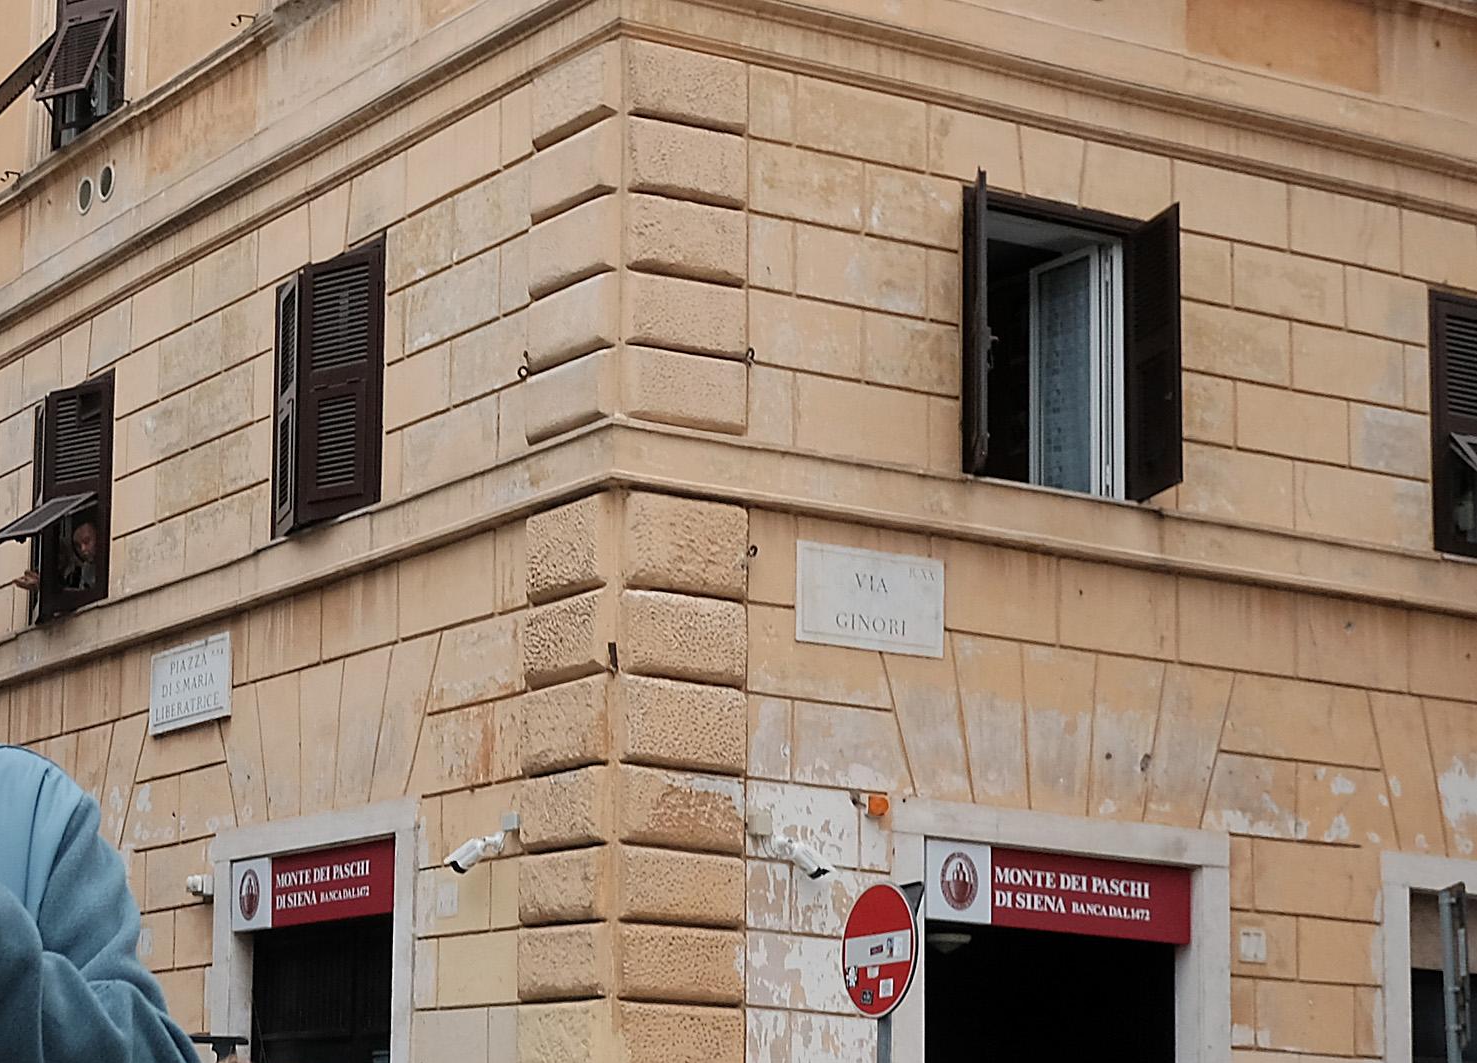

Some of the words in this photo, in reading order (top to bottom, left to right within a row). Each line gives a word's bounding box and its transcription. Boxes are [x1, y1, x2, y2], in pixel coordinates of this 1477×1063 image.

[855, 572, 888, 593] VIA
[835, 612, 906, 637] GINORI
[169, 652, 208, 676] PIAZZA
[162, 683, 172, 698] DI
[155, 691, 220, 722] LIBERATRICE
[276, 868, 311, 888] MONTE
[313, 866, 330, 884] DEI
[333, 859, 370, 880] PASCHI
[994, 866, 1056, 889] MONTE
[1060, 873, 1087, 892] DEI
[1091, 877, 1150, 899] PASCHI
[276, 894, 286, 910] DI
[287, 890, 317, 908] SIENA
[320, 890, 342, 903] BANCA
[994, 890, 1013, 908] DI
[1015, 892, 1066, 914] SIENA
[1071, 902, 1108, 917] BANCA
[1108, 906, 1129, 919] DAL
[1130, 908, 1151, 921] 1472
